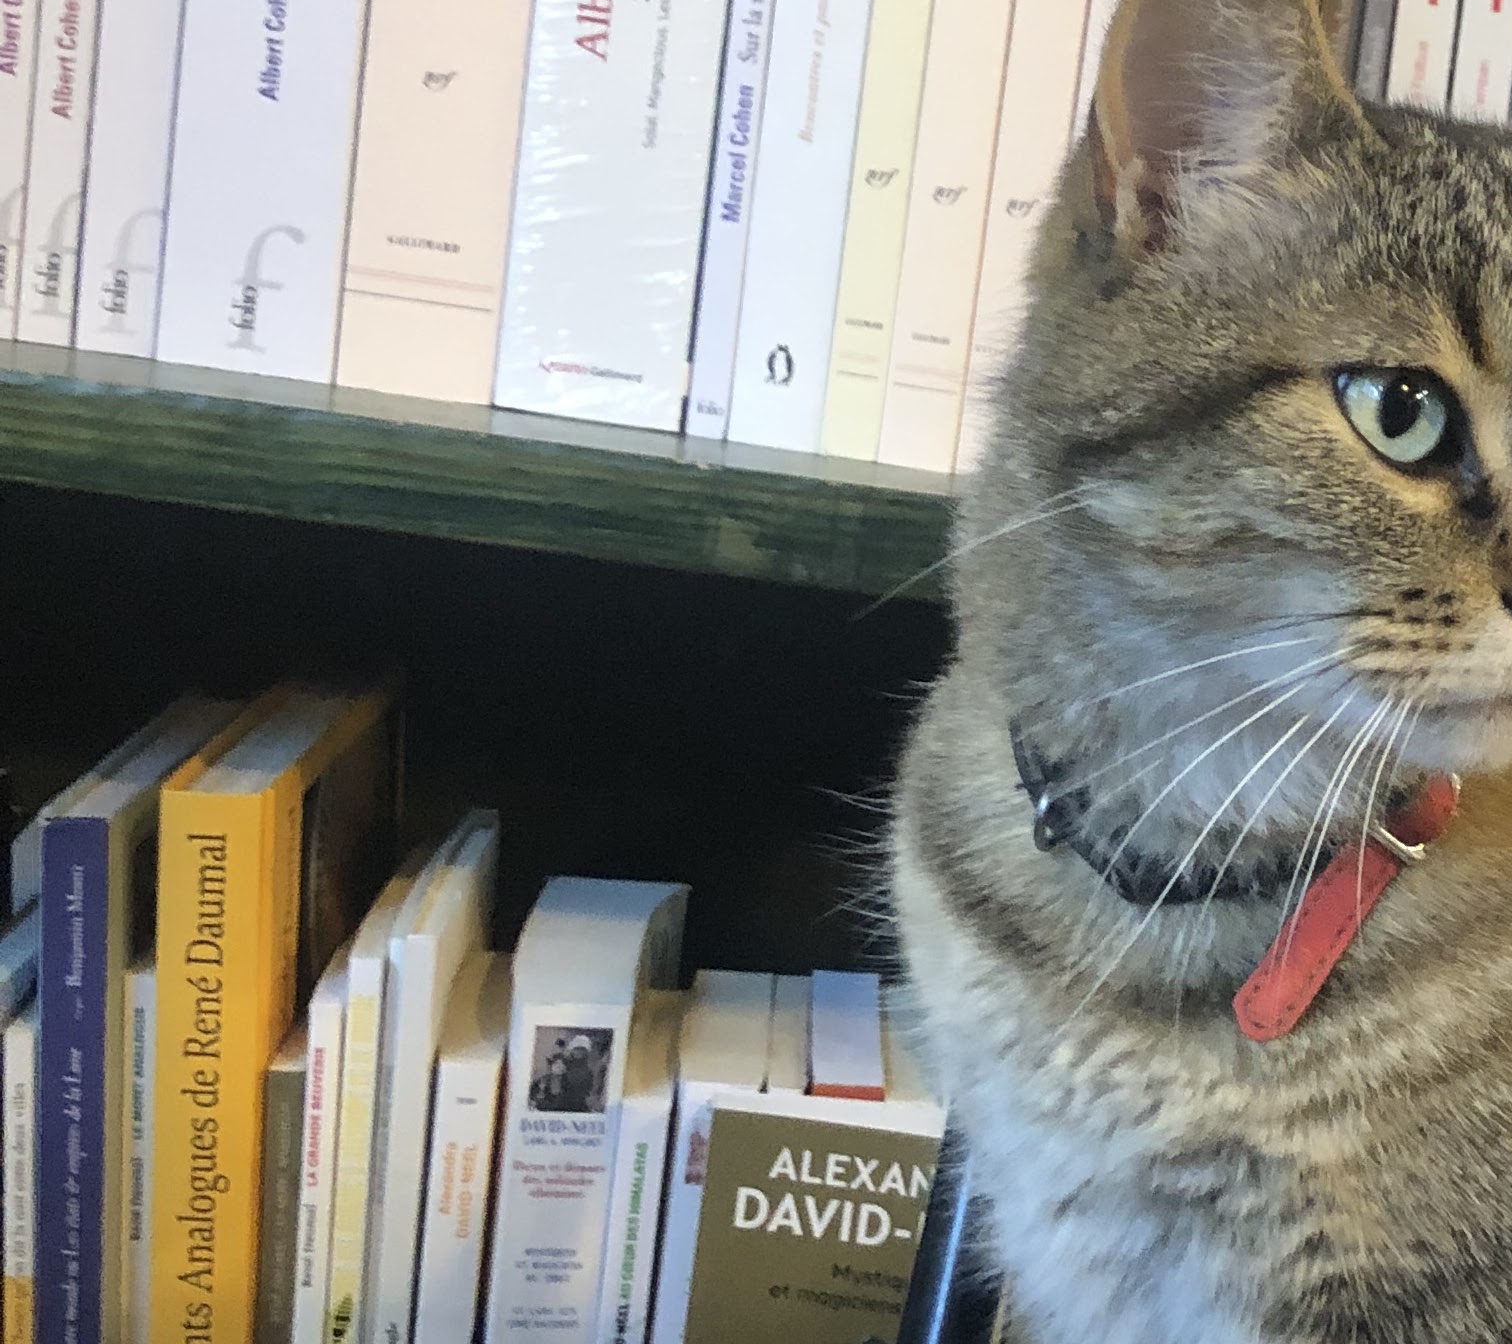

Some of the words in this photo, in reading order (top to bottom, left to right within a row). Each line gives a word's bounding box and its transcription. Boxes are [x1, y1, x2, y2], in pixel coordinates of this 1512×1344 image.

[0, 11, 23, 77] Albert
[738, 28, 760, 65] Sur
[748, 4, 763, 25] la
[51, 52, 78, 120] Albert
[258, 36, 284, 102] Albert
[729, 84, 754, 147] Cohen
[721, 153, 746, 224] Marcel
[35, 252, 62, 299] folio
[100, 269, 129, 315] folio
[229, 286, 258, 332] folio
[185, 832, 229, 966] Daumal
[184, 976, 223, 1059] René
[181, 1070, 219, 1107] de
[176, 1118, 231, 1293] Analogues
[438, 1141, 457, 1215] Alexandra
